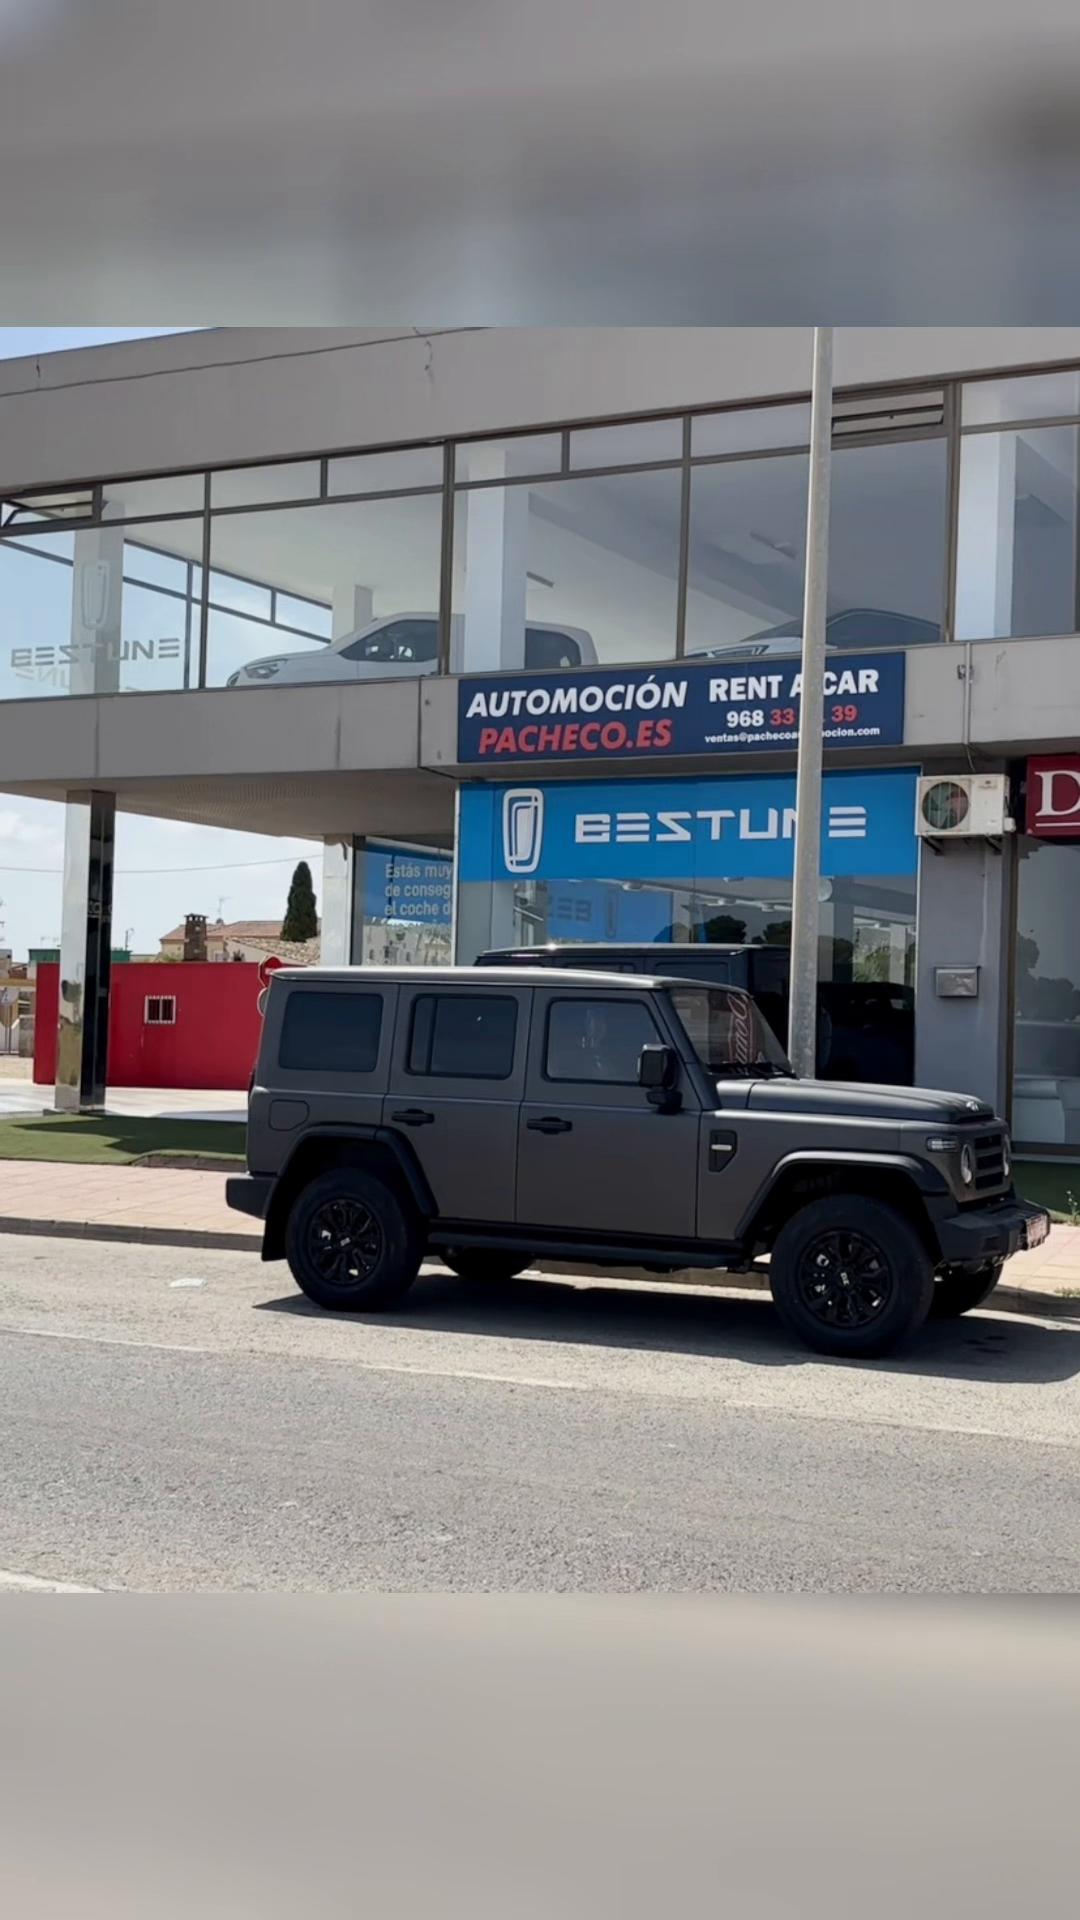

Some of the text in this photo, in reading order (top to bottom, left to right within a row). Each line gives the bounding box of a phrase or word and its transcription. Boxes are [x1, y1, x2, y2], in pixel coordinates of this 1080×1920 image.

[465, 674, 688, 718] AUTOMOCIÓN
[709, 675, 783, 703] RENT
[823, 668, 879, 696] CAR
[726, 704, 858, 728] 968 33 39
[478, 719, 673, 754] PACHECO.ES
[385, 862, 452, 880] Estás muy
[384, 883, 451, 900] de conseg
[384, 900, 397, 916] el
[400, 900, 439, 916] coche
